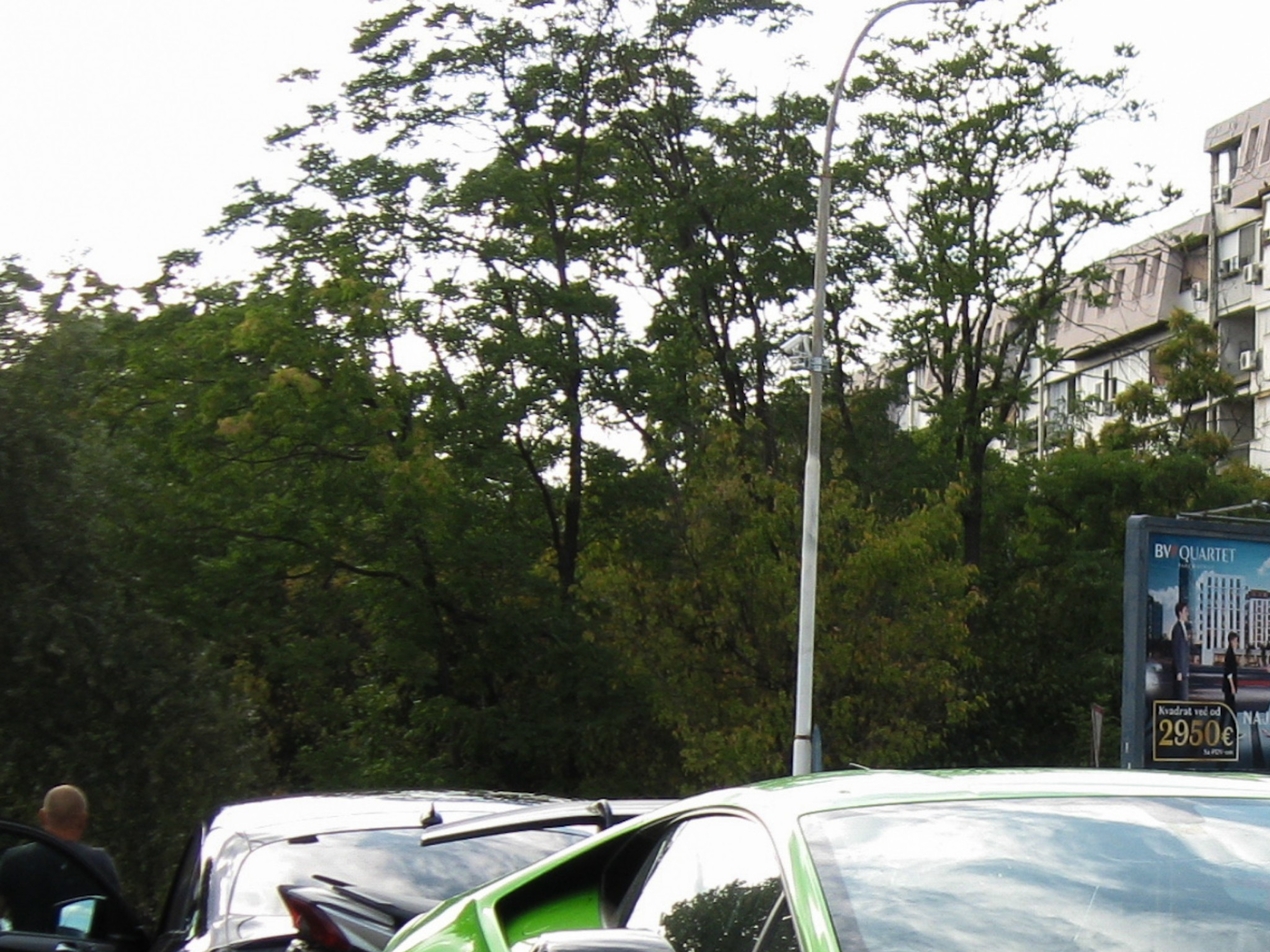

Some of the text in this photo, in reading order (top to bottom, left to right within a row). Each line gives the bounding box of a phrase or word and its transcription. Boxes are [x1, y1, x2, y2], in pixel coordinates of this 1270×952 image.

[1179, 545, 1237, 563] QUARTET
[1158, 705, 1192, 716] Kvadrat
[1210, 706, 1221, 717] od
[1159, 719, 1234, 747] 2950€
